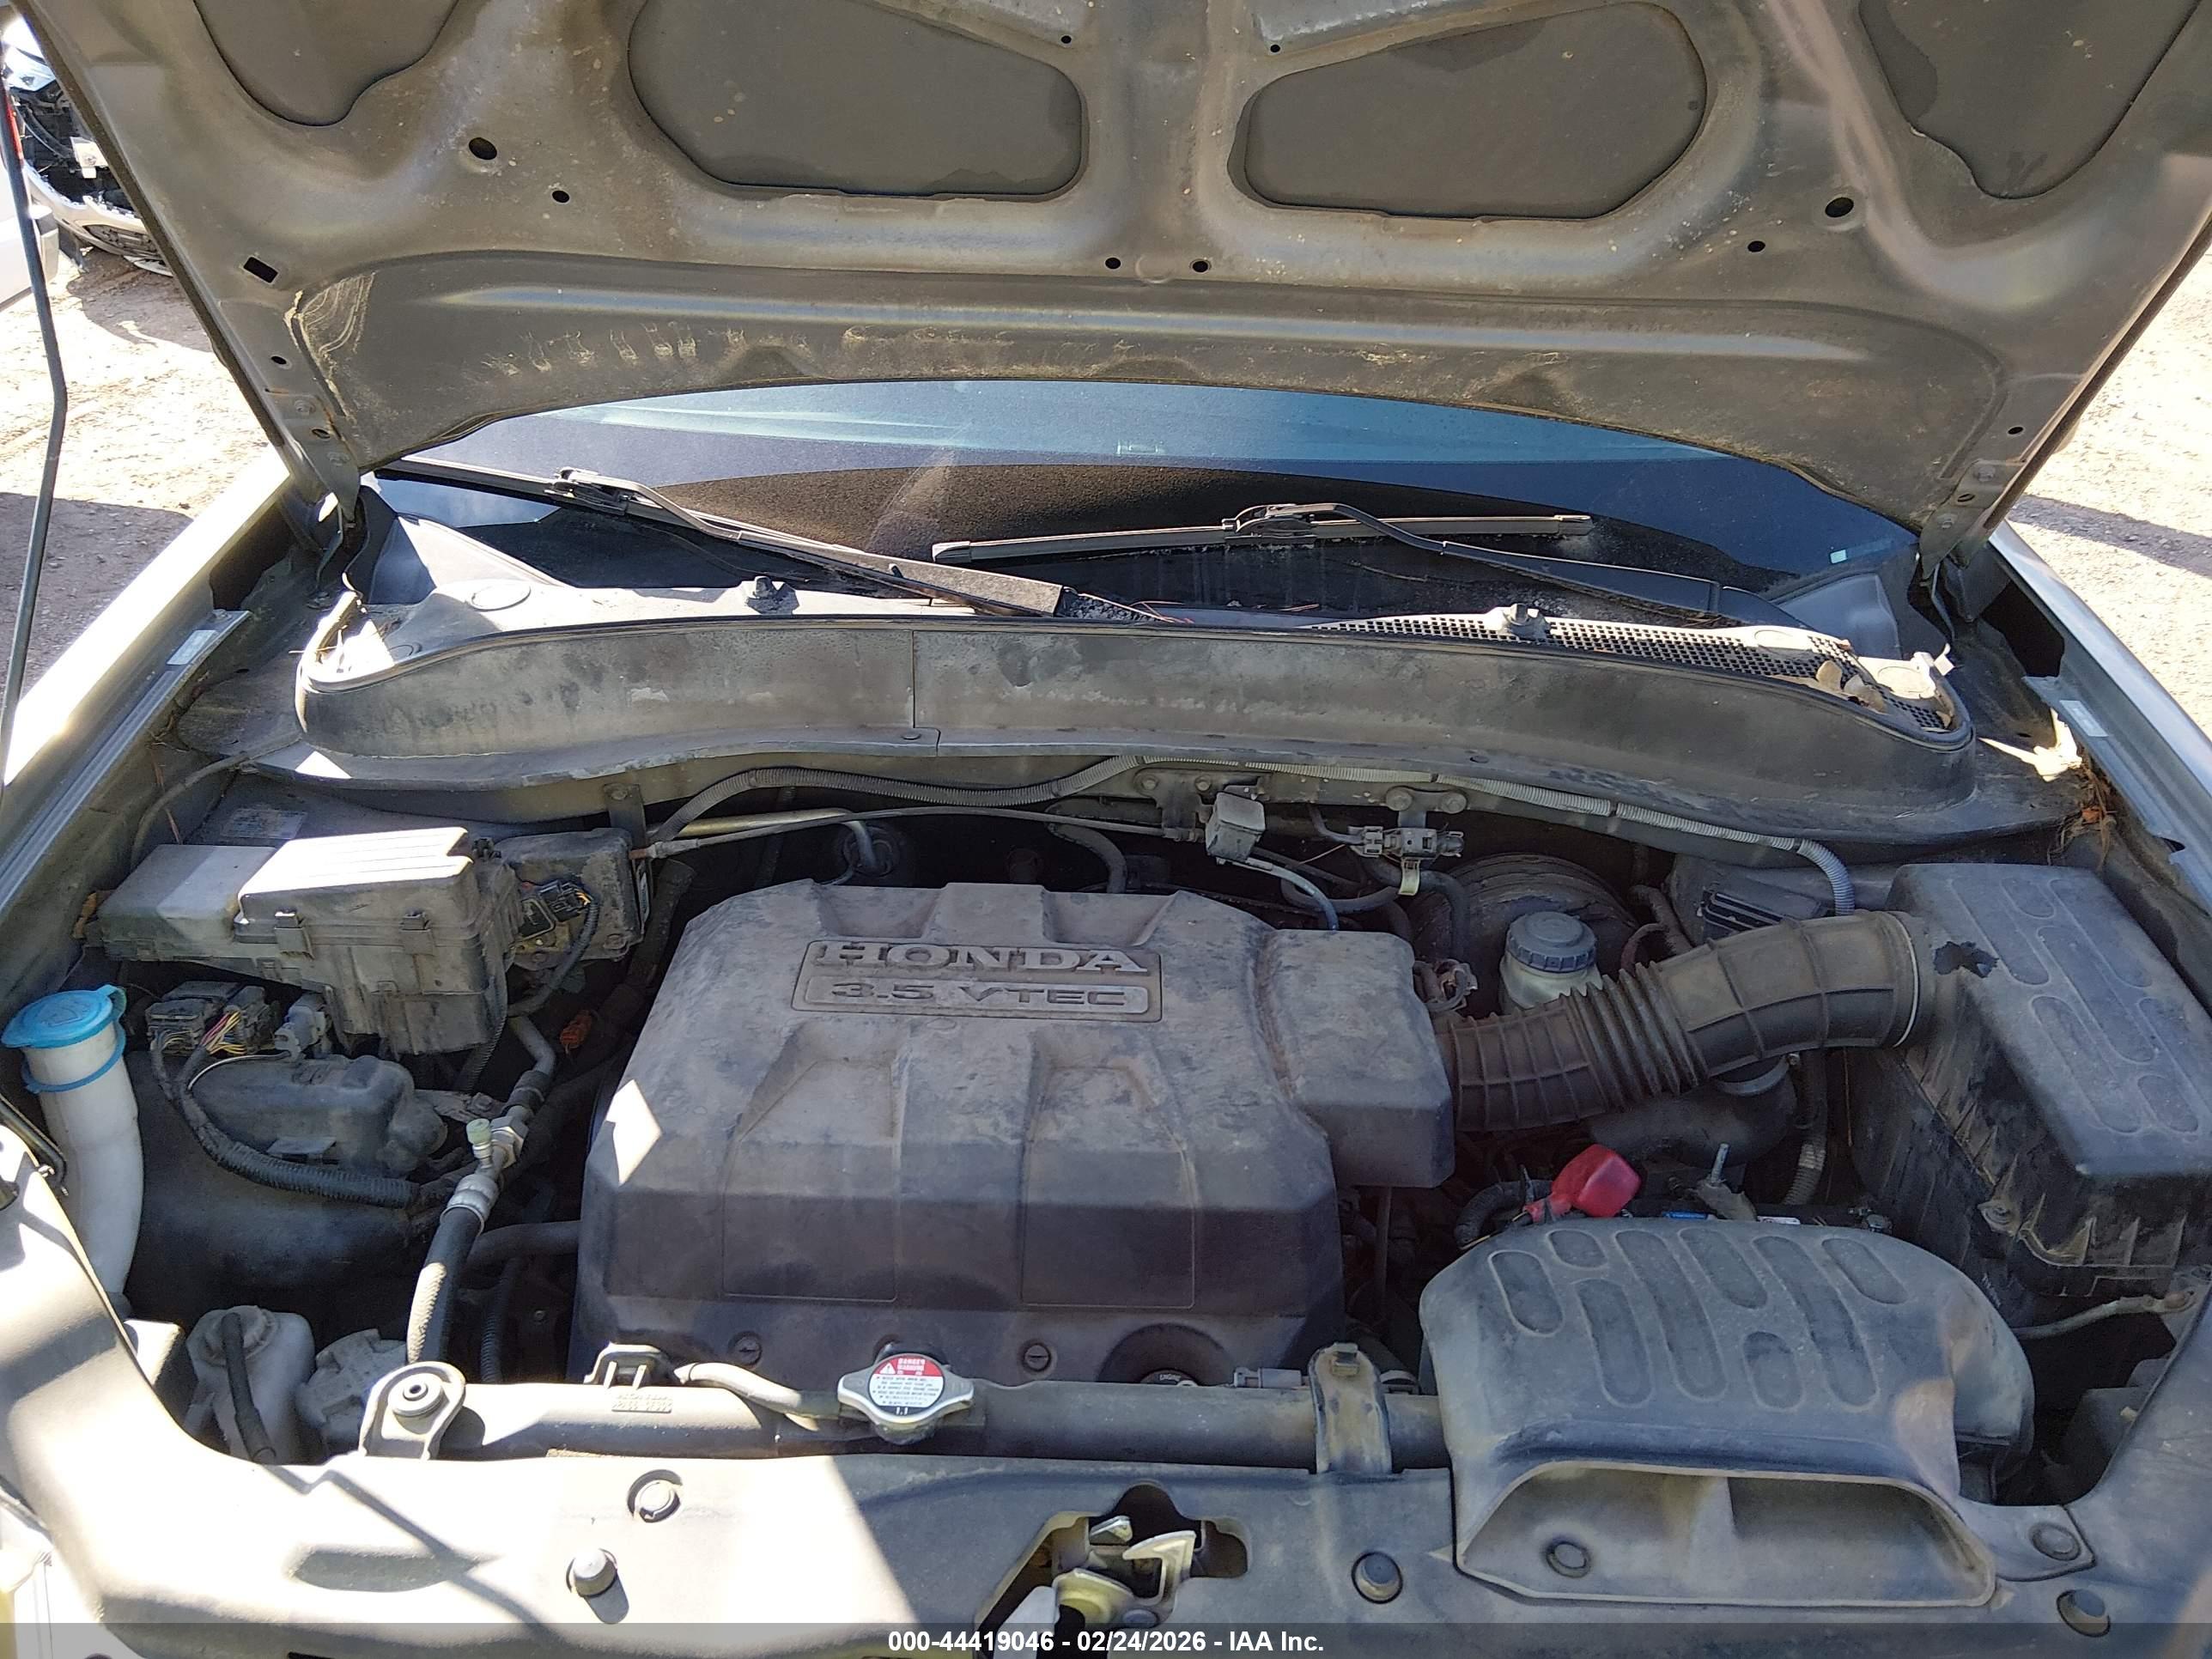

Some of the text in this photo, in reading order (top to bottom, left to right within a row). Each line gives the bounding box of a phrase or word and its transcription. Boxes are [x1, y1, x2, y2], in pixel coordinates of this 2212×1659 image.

[811, 940, 1148, 974] HONDA
[832, 981, 1126, 1006] 3.5 VTEC
